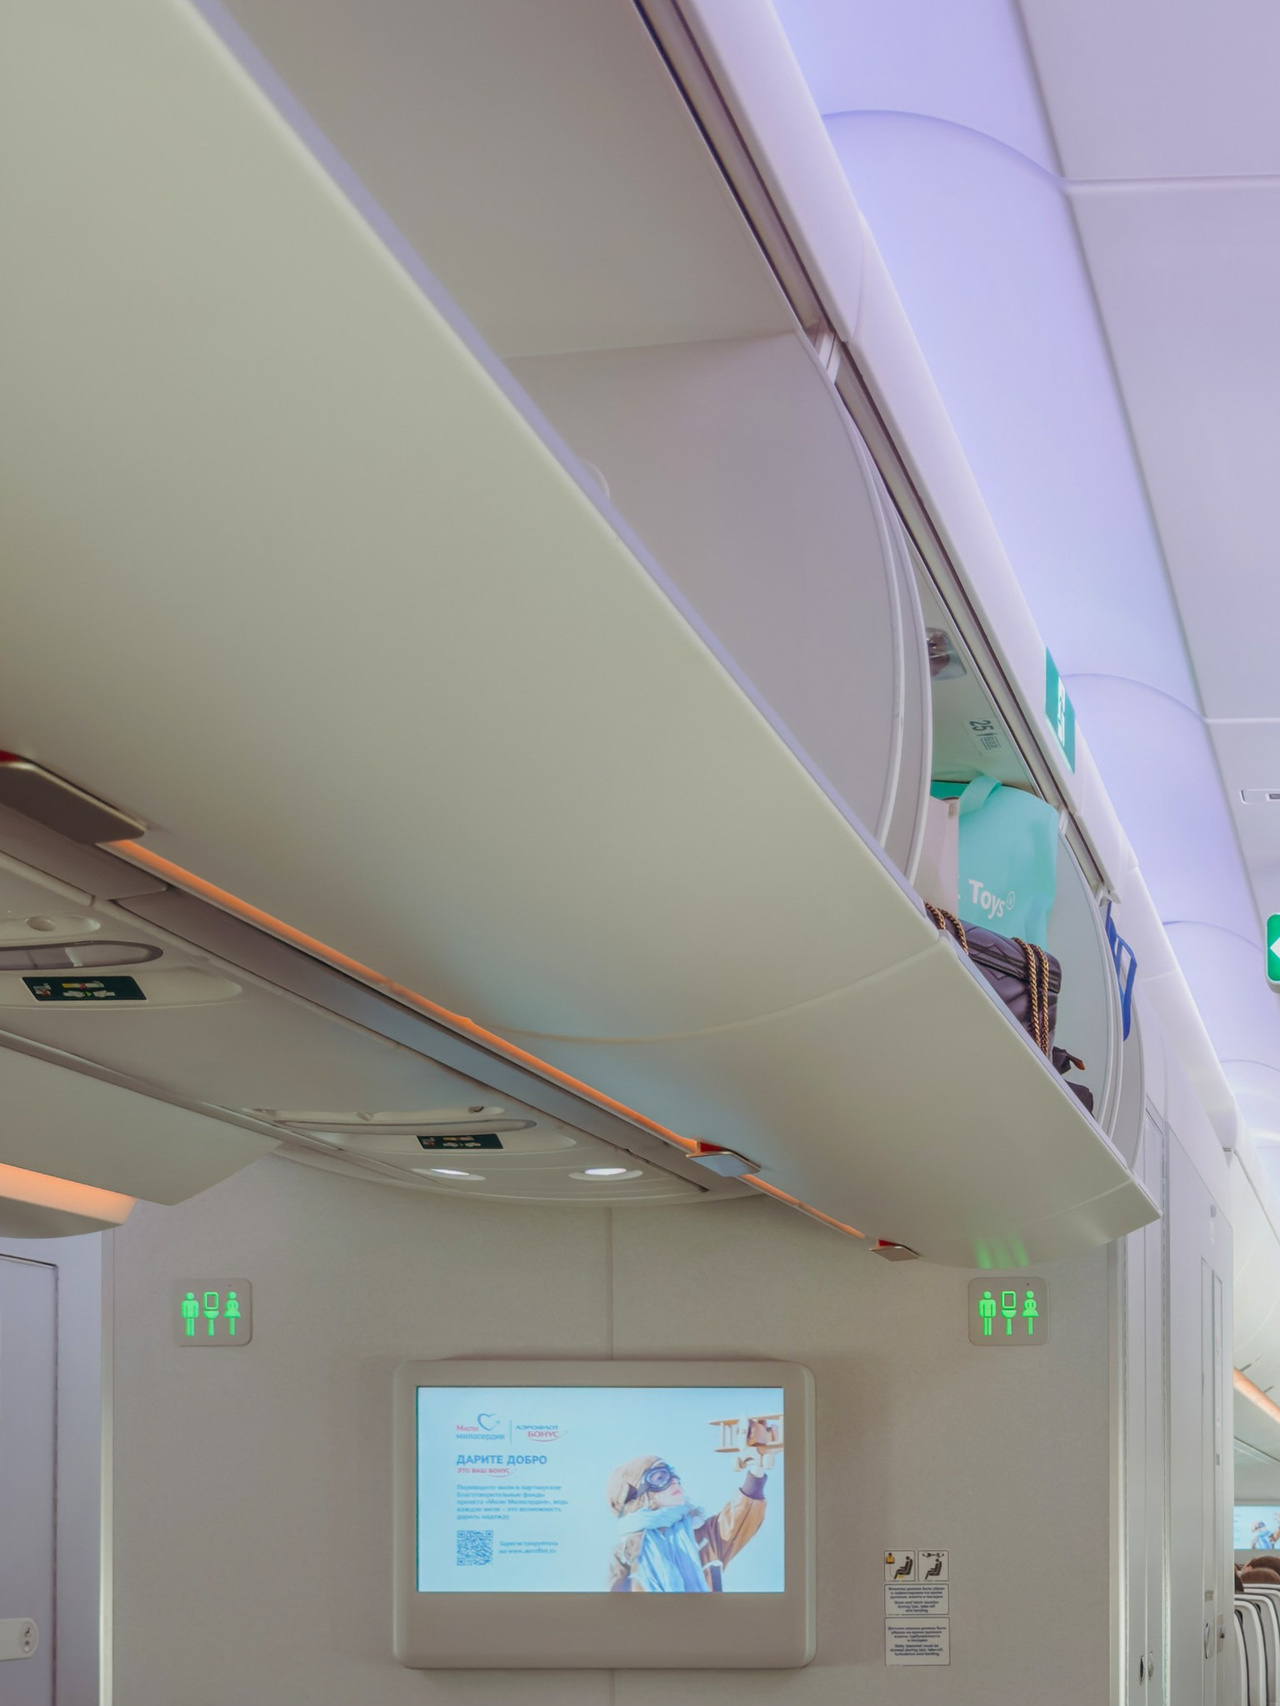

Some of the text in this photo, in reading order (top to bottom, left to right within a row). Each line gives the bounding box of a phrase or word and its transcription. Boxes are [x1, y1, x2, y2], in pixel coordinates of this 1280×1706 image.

[969, 719, 995, 732] 25
[527, 1430, 559, 1438] БОНУС
[456, 1454, 548, 1466] ДАРИТЕ ДОБРО
